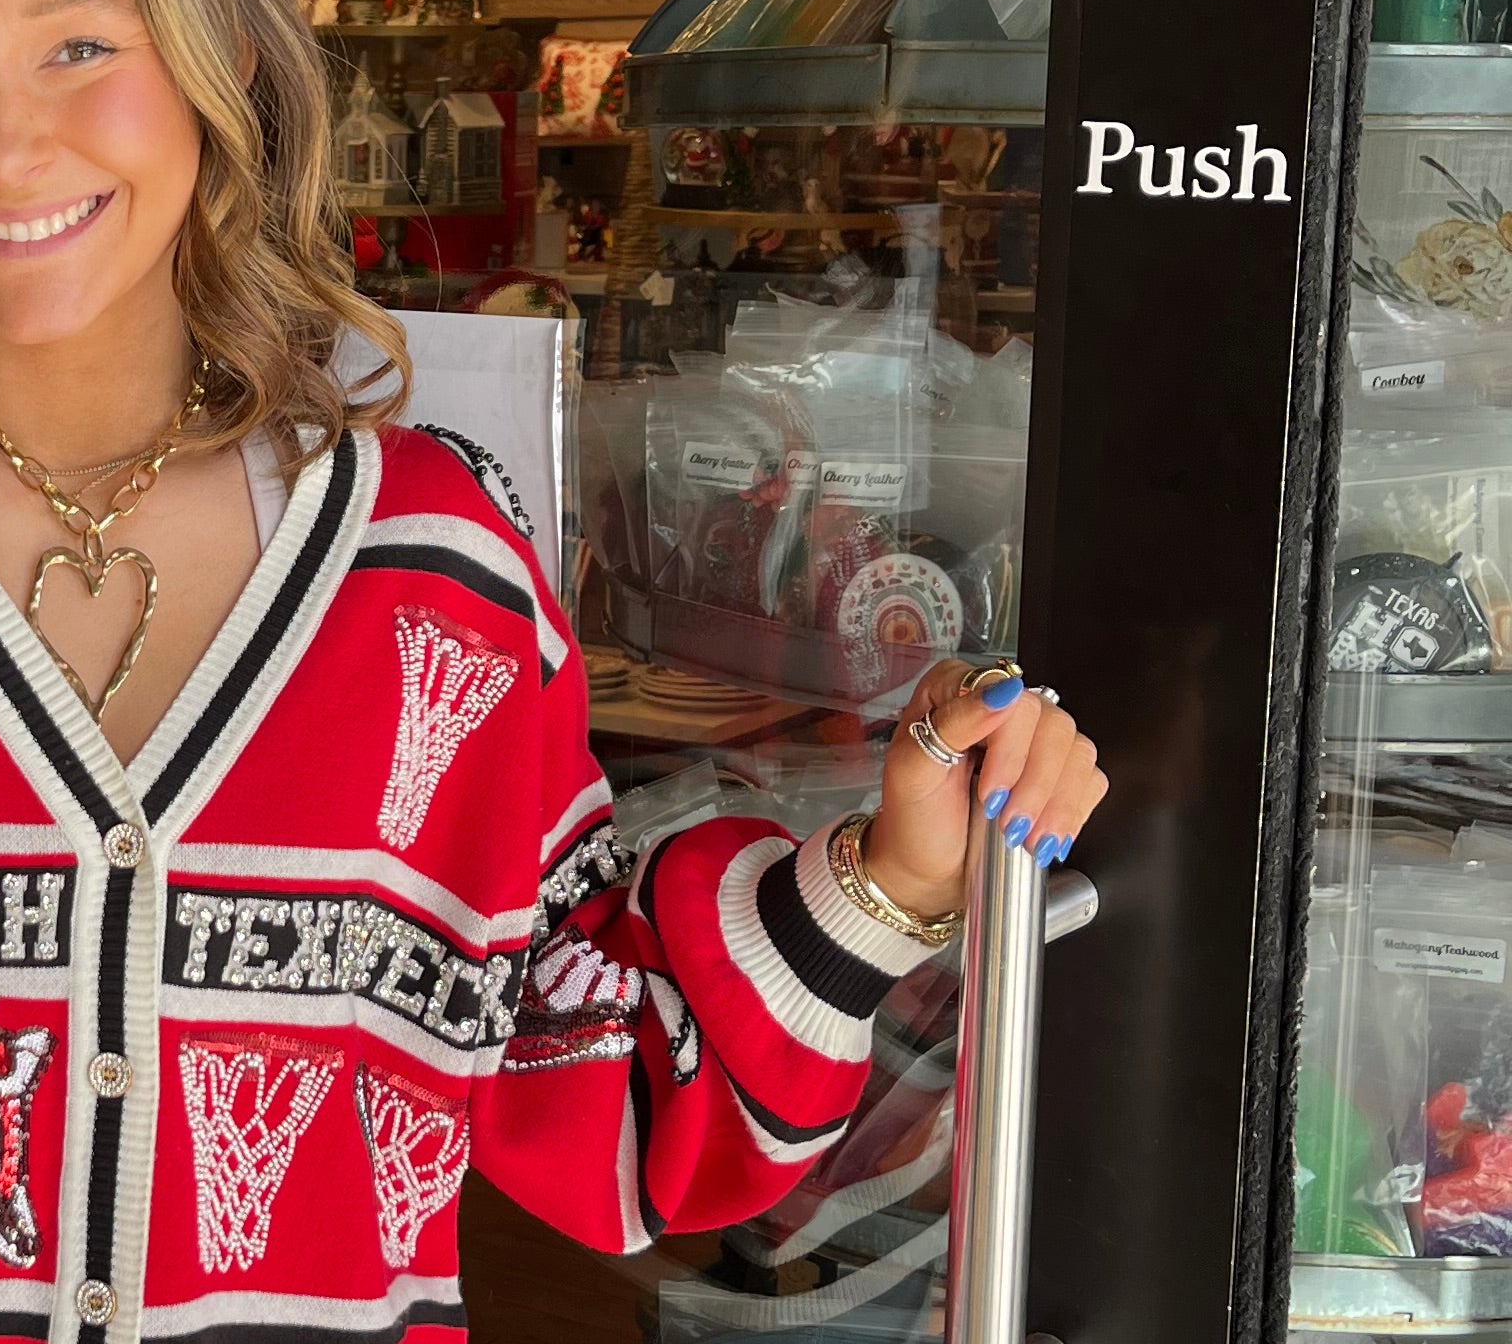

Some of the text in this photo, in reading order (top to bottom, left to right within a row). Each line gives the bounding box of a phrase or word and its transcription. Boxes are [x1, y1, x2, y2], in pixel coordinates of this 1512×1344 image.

[1077, 119, 1291, 203] Push
[1372, 372, 1426, 391] Cowboy
[689, 452, 755, 470] Cherry Leather
[823, 470, 861, 487] Cherry
[864, 472, 904, 487] Leather
[1384, 587, 1440, 630] TEXAS
